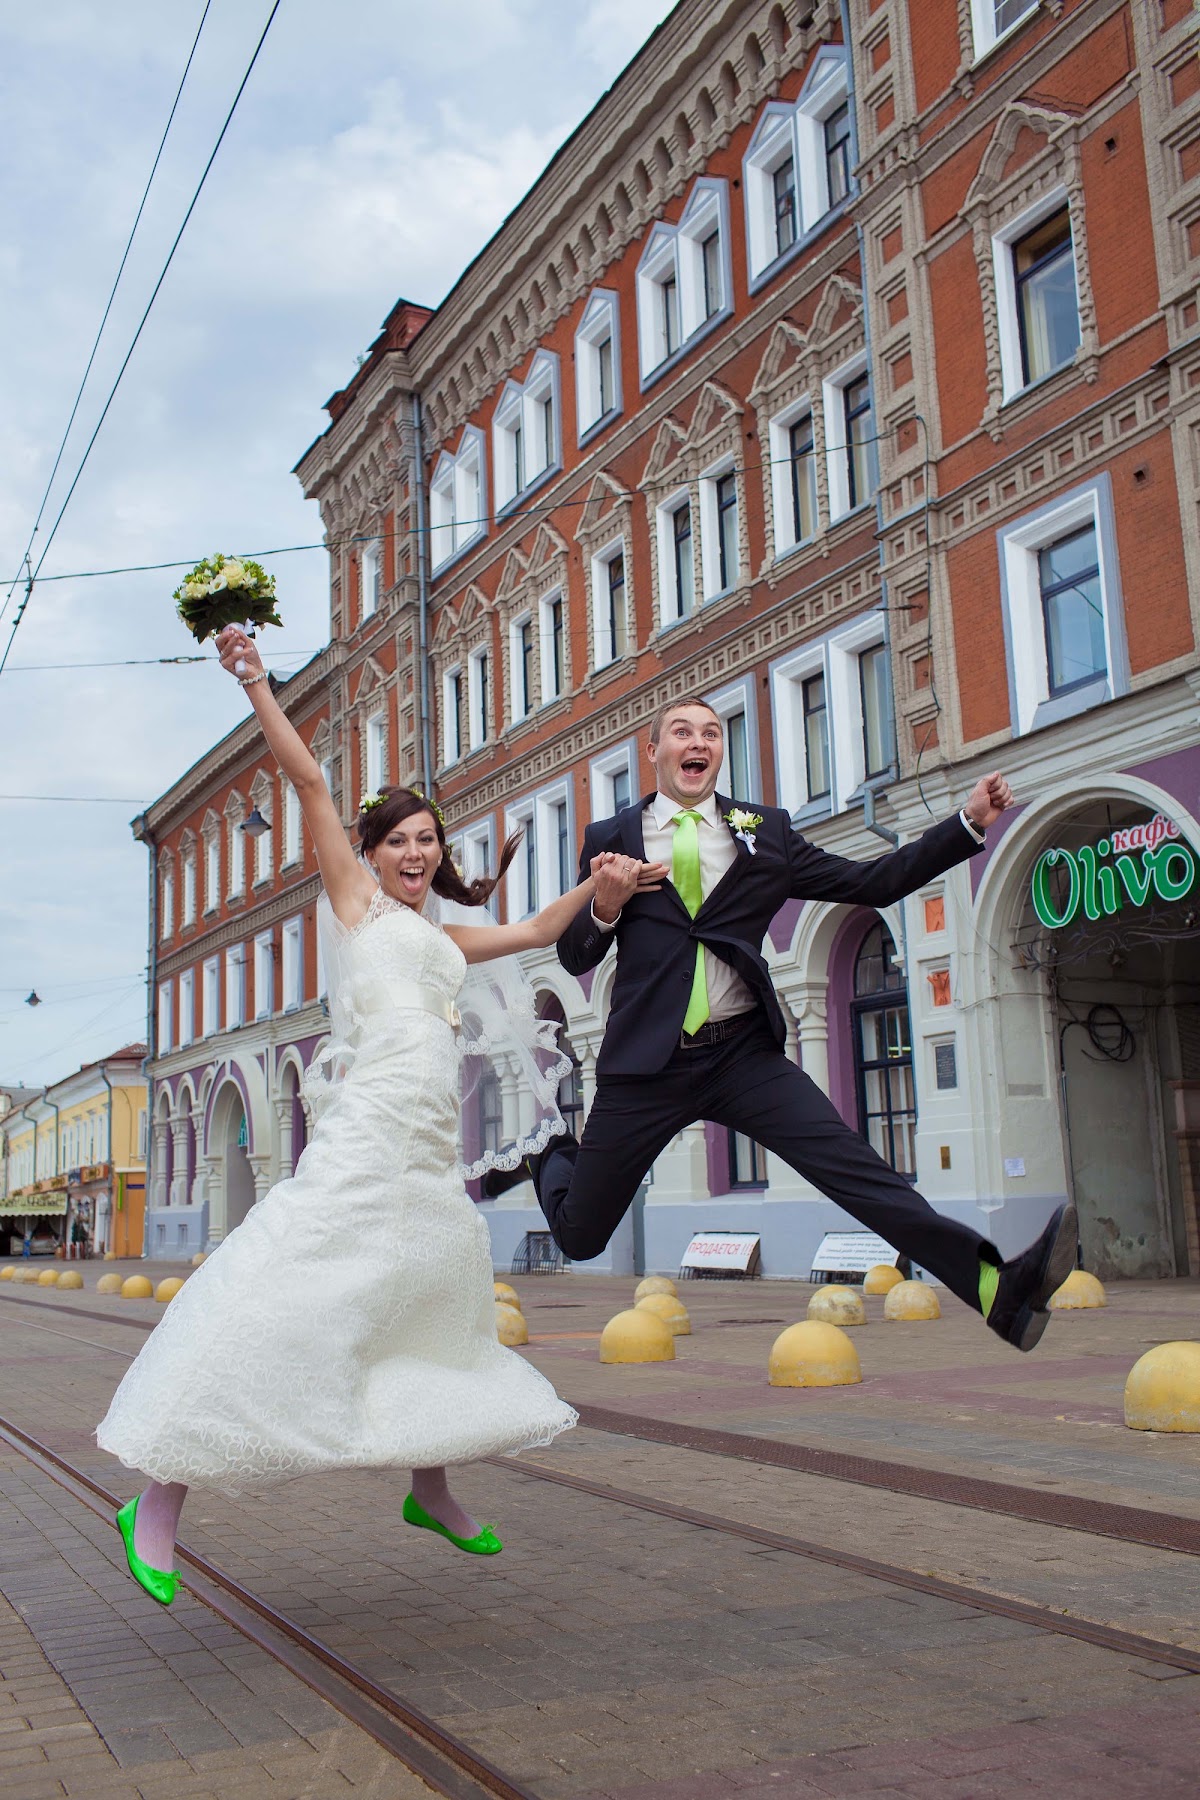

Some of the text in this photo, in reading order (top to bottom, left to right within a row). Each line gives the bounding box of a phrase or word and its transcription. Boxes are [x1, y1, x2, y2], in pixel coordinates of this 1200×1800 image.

[1113, 814, 1180, 852] кафе
[1032, 839, 1195, 929] Olivo
[688, 1242, 741, 1256] ПРОДАЕТСЯ
